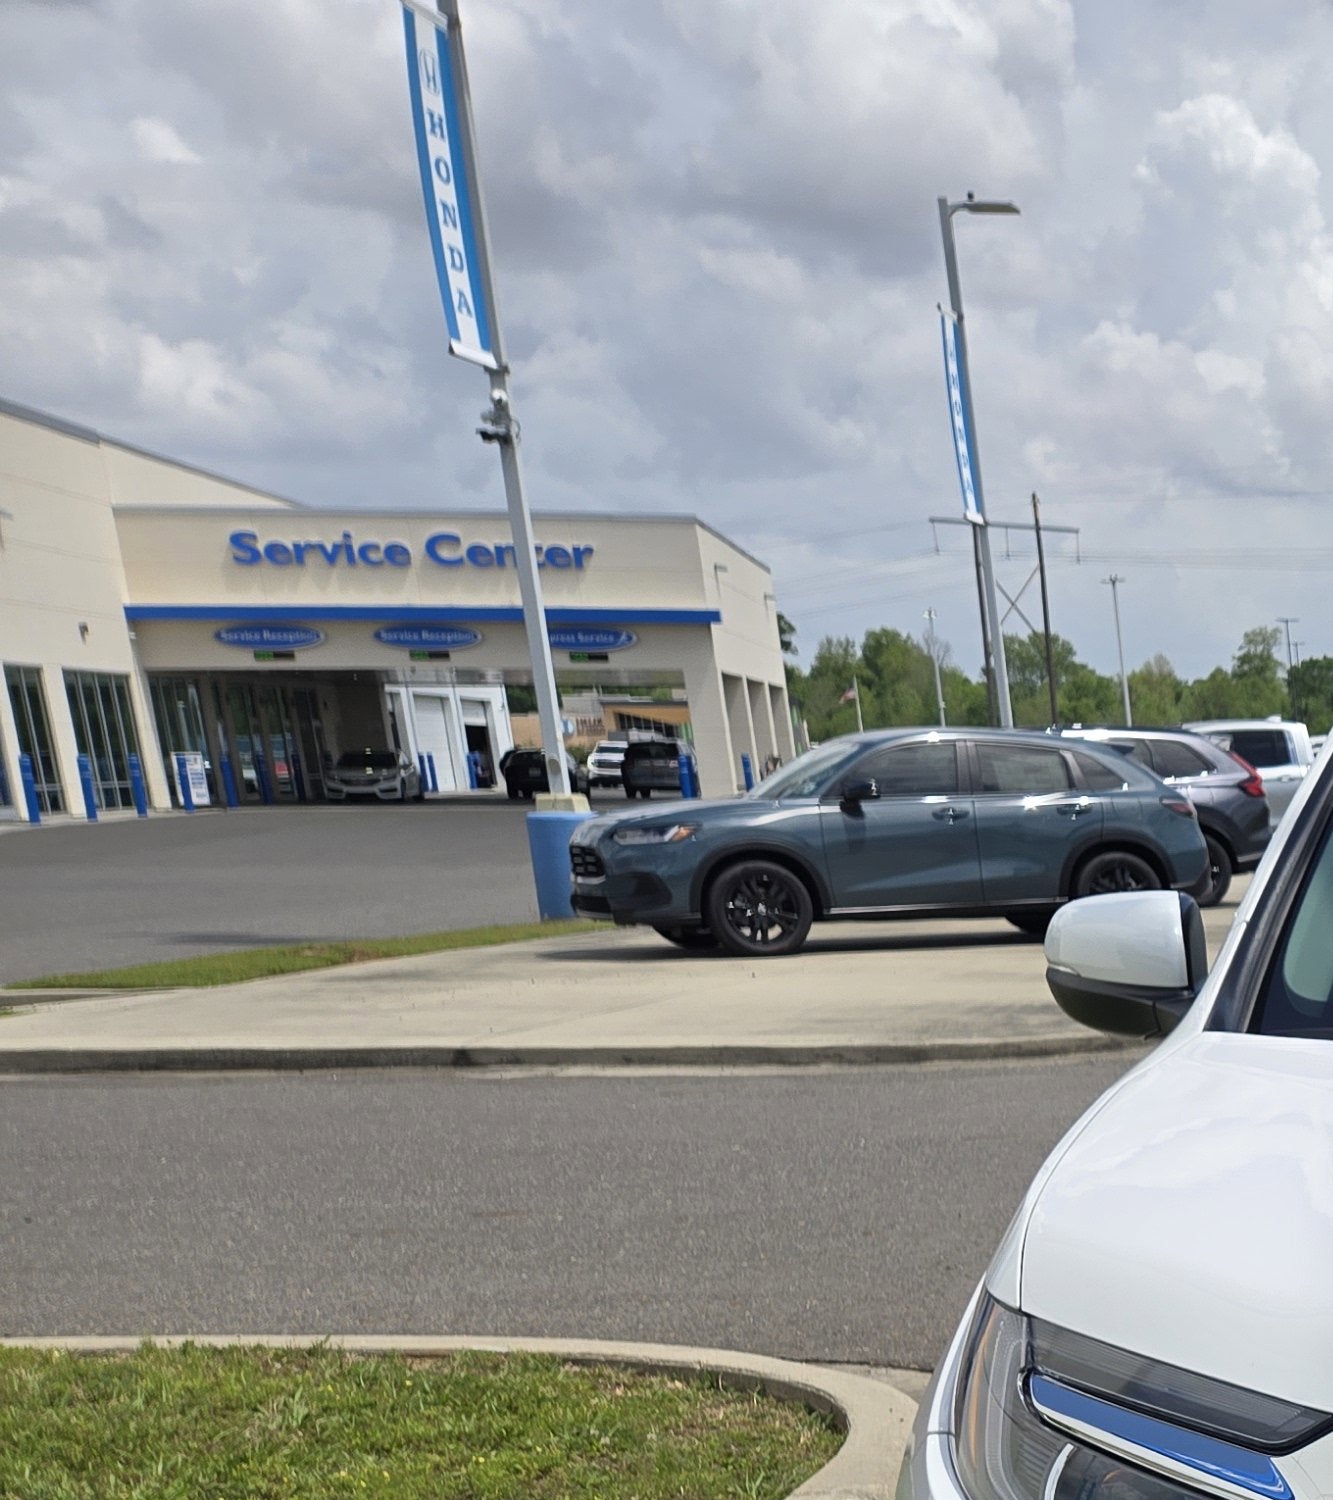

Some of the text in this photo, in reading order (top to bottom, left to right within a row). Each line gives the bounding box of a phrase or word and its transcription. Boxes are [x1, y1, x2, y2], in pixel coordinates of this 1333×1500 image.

[427, 108, 473, 318] HONDA
[229, 530, 594, 568] Service Cener
